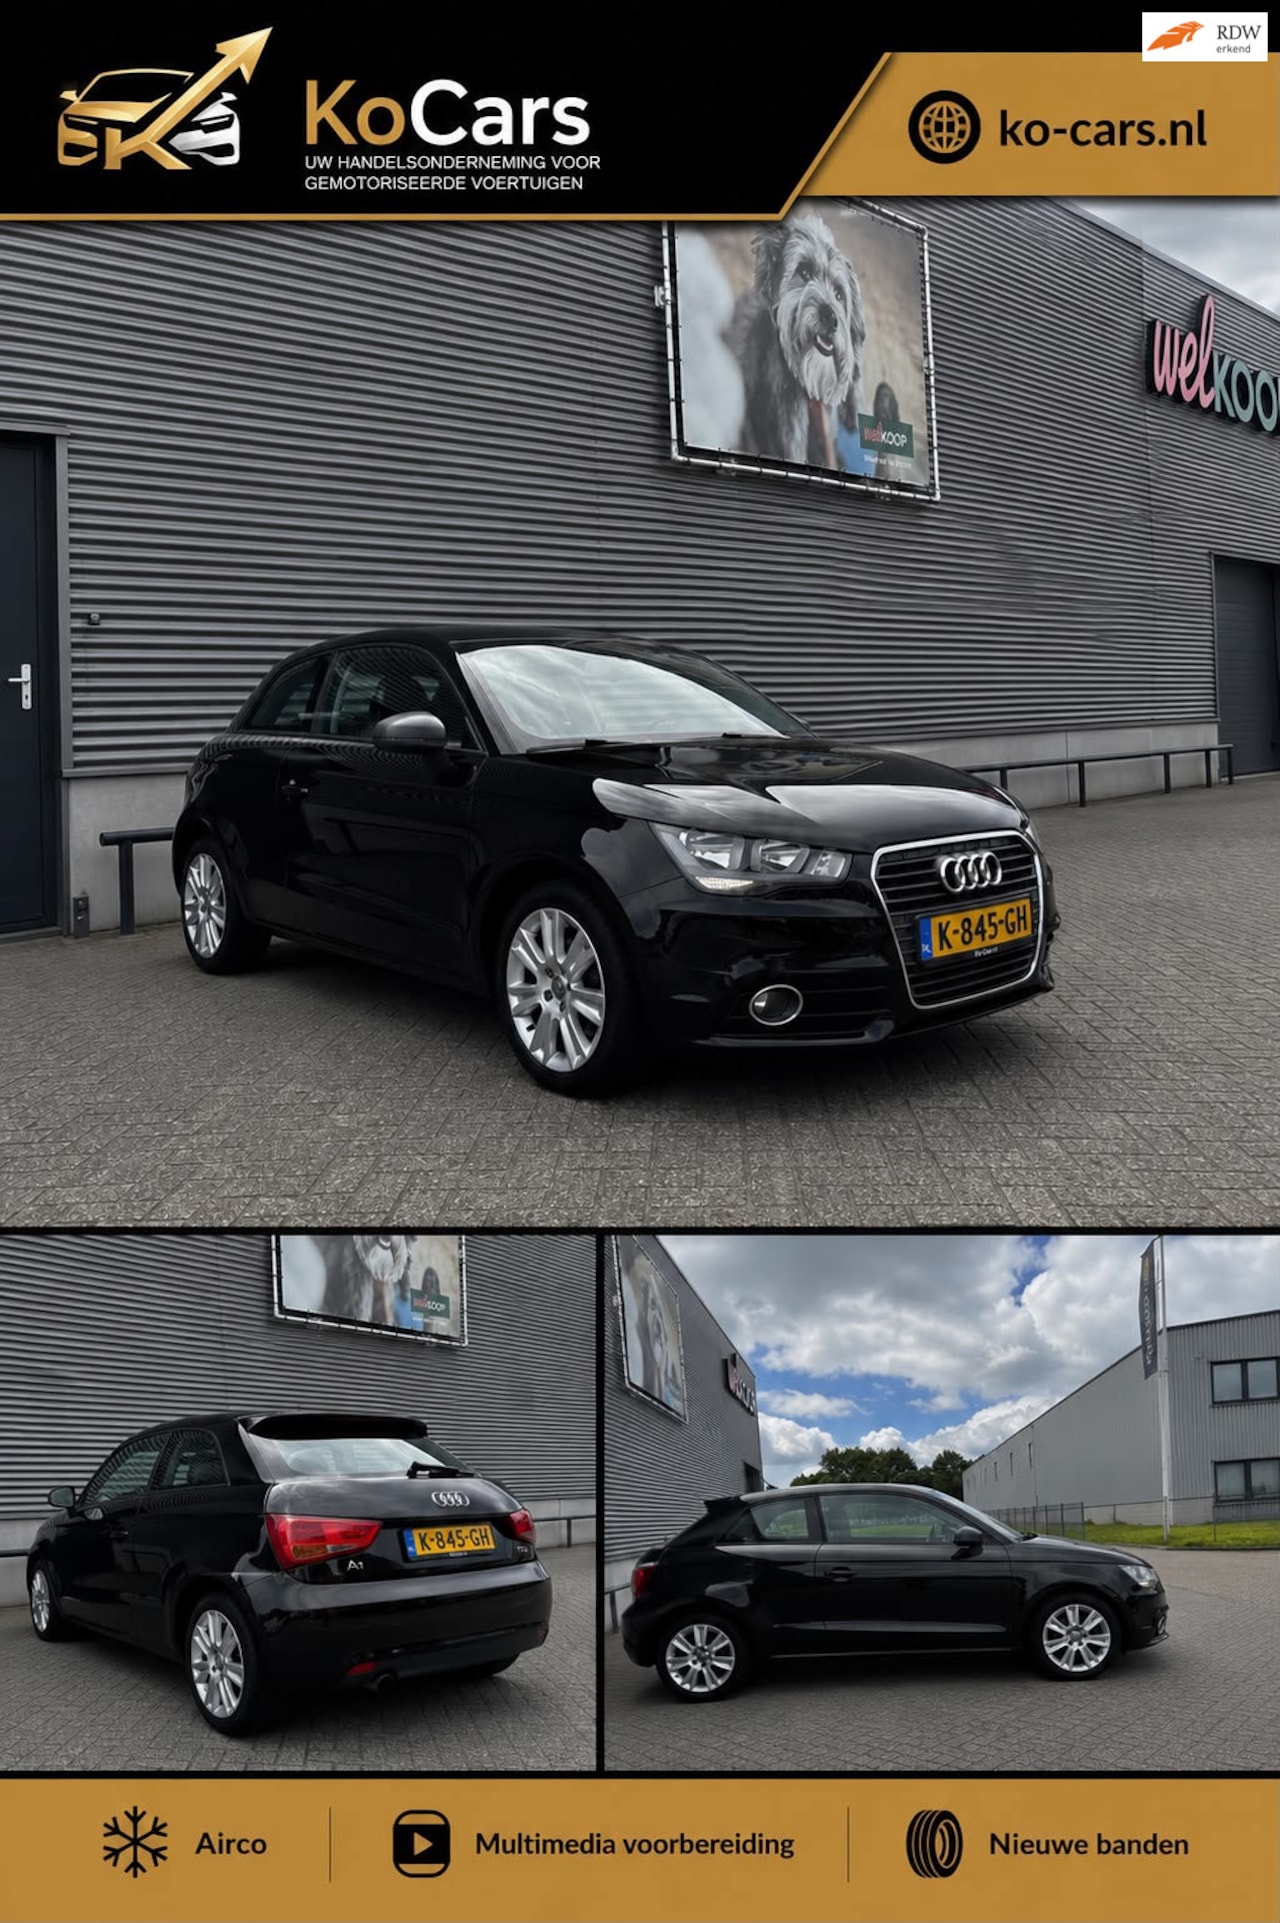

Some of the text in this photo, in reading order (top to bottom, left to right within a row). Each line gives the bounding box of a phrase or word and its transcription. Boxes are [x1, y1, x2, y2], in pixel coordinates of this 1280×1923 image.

[1153, 294, 1280, 432] welKOO
[937, 904, 1028, 951] K-845-GH
[418, 1527, 490, 1552] K-845-GH
[346, 1560, 364, 1571] A1
